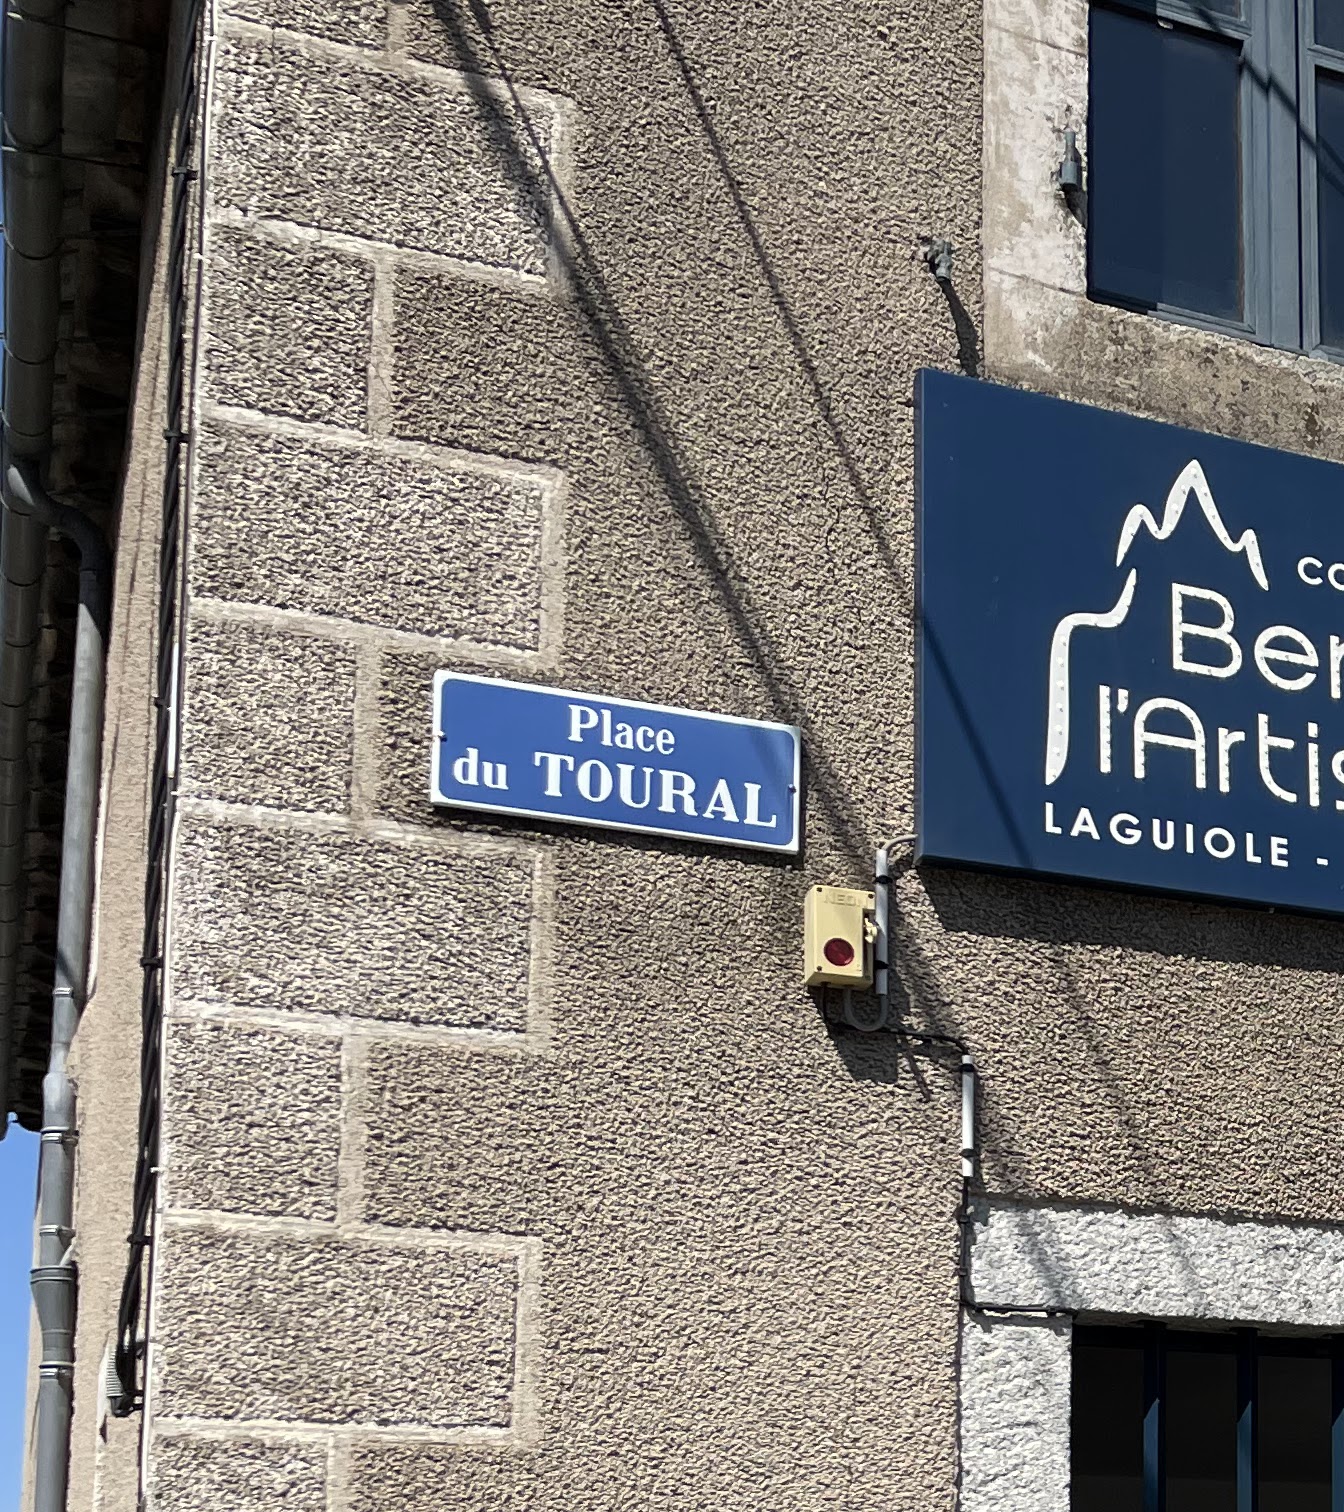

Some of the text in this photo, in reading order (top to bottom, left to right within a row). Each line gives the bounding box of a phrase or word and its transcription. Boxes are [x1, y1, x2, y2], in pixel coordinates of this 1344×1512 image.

[567, 703, 676, 755] Place
[452, 747, 777, 828] du TOURAL
[1045, 801, 1290, 868] LAGUIOLE
